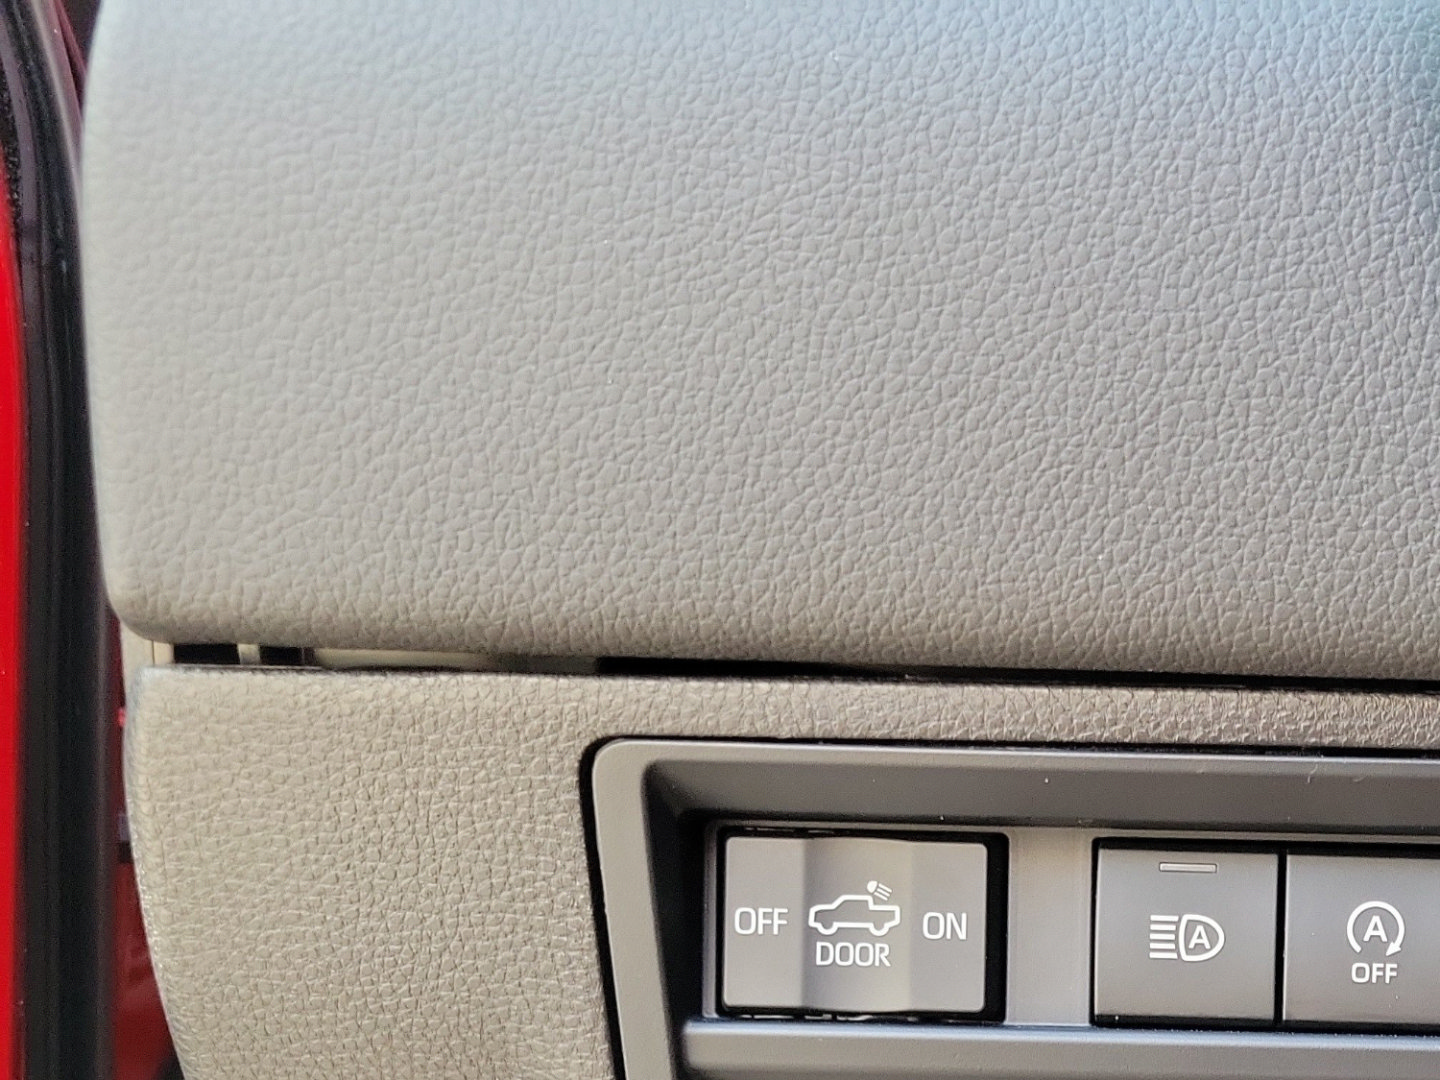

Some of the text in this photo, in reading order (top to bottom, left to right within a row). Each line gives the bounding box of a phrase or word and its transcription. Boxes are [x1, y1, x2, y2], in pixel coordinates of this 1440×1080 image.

[734, 907, 789, 935] OFF
[922, 912, 967, 940] ON
[1363, 915, 1388, 942] A
[1188, 925, 1211, 950] A
[815, 941, 891, 967] DOOR
[1351, 962, 1398, 984] OFF
